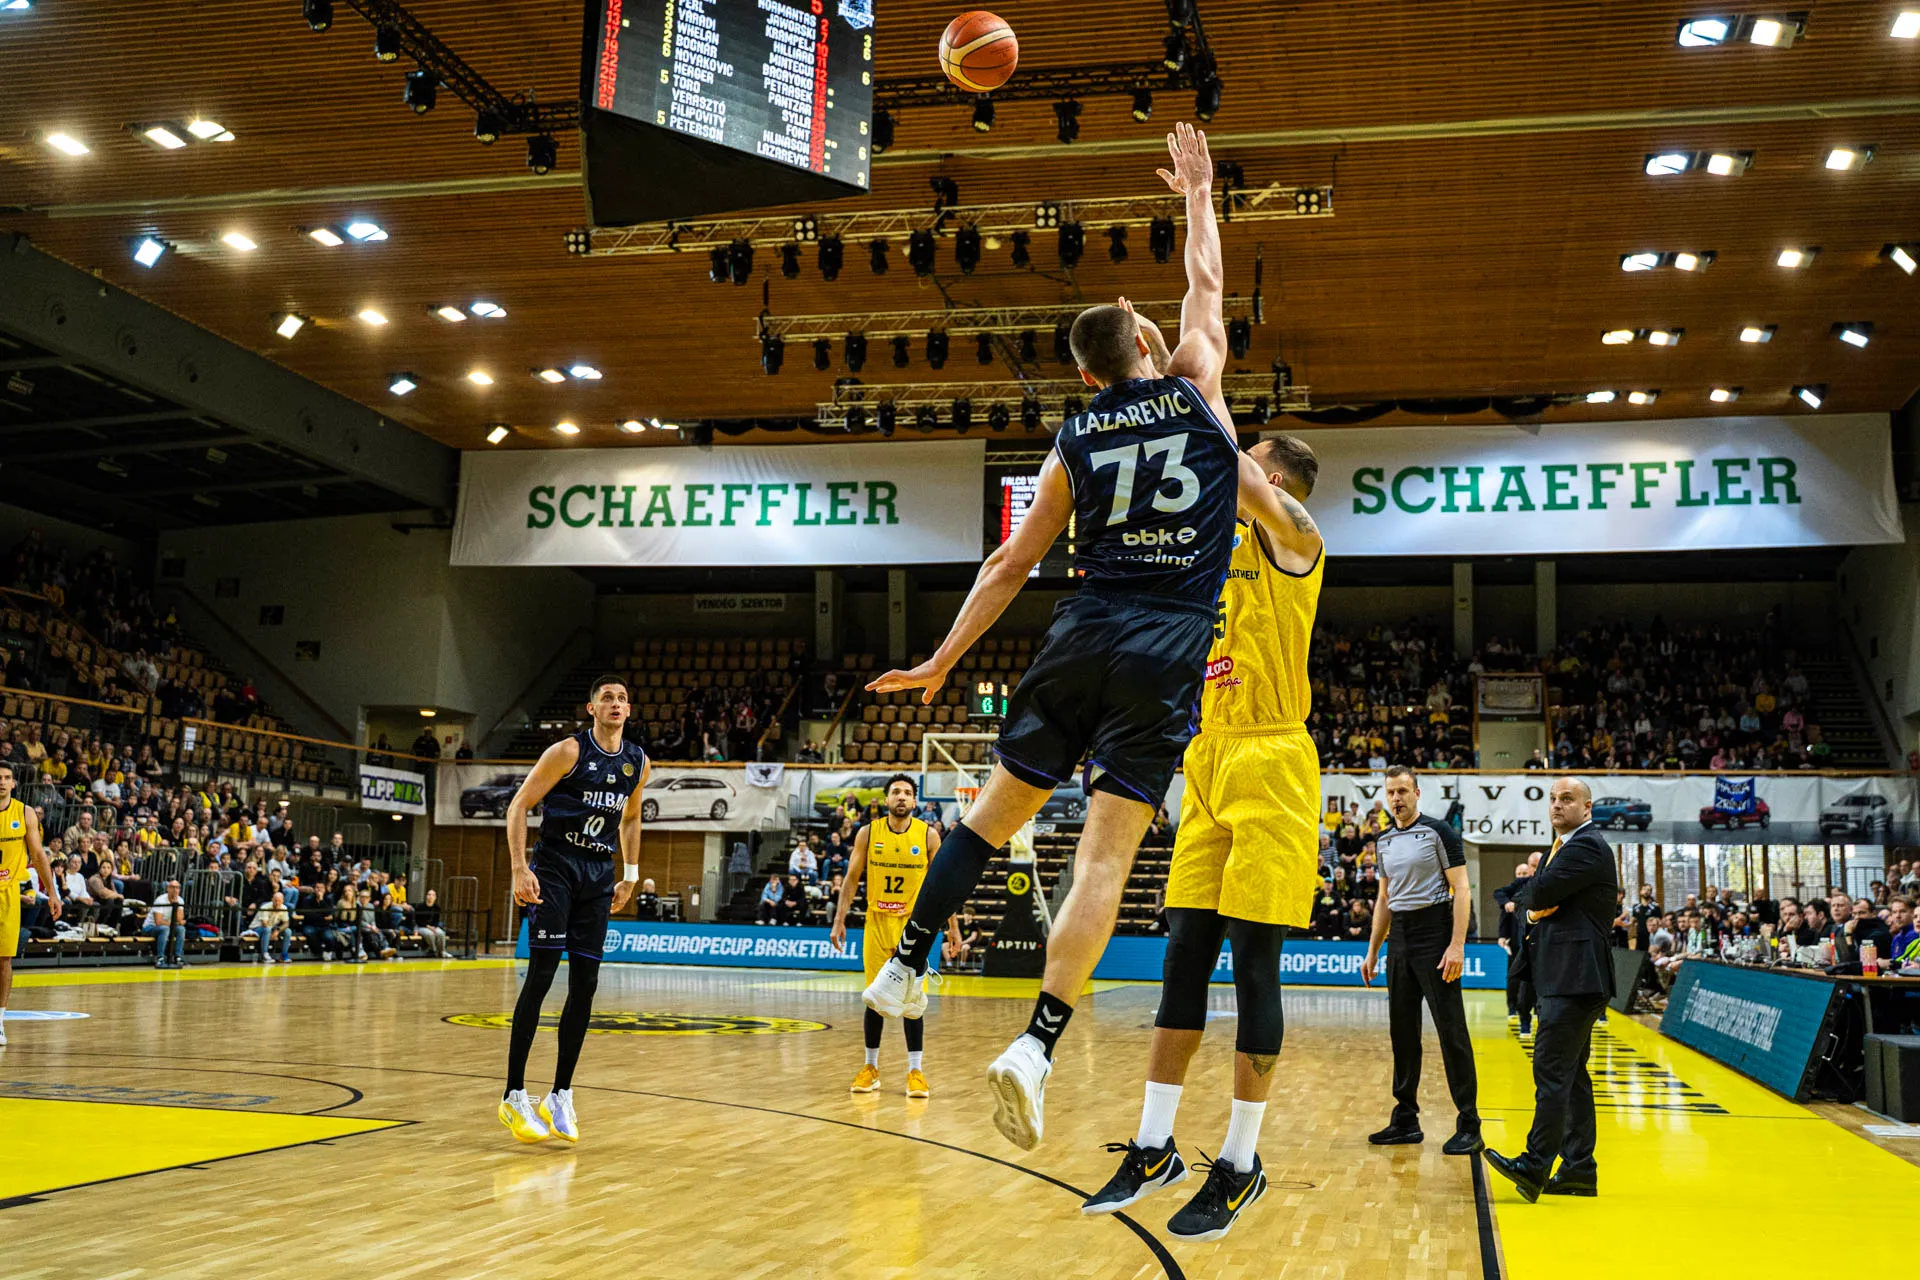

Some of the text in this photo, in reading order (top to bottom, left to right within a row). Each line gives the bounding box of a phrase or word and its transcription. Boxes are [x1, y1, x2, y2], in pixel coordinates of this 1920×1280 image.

[757, 0, 817, 28] NORMANTAS
[663, 29, 673, 43] 2
[677, 20, 719, 45] WHELAN
[766, 13, 816, 40] JAWORSKI
[662, 43, 671, 57] 6
[765, 25, 816, 53] KRAMPELJ
[675, 47, 734, 77] NOVAKOVIC
[773, 40, 815, 65] HILLIARD
[660, 69, 669, 84] 5
[674, 61, 714, 85] HERGER
[762, 63, 813, 90] BAGAYOKO
[769, 52, 815, 78] MINTEGUI
[673, 74, 701, 93] TORO
[763, 76, 813, 103] PETRASEK
[862, 71, 871, 86] 6
[670, 101, 726, 129] FILIPOVITY
[768, 91, 812, 116] PANTZAR
[657, 110, 666, 125] 5
[669, 115, 724, 142] PETERSON
[781, 109, 812, 130] SYLLA
[860, 121, 868, 135] 5
[763, 130, 810, 155] HLINASON
[786, 123, 811, 142] FONT
[757, 141, 809, 168] LAZAREVIC
[858, 146, 867, 160] 6
[1089, 432, 1200, 527] 73
[1352, 457, 1802, 515] SCHAEFFLER
[527, 481, 899, 529] SCHAEFFLER
[1122, 528, 1175, 546] bbk
[1117, 549, 1197, 569] eling
[1356, 785, 1545, 801] VLVO
[582, 815, 605, 837] 10
[1464, 815, 1545, 836] TÓ KFT.
[884, 876, 904, 894] 12
[622, 933, 859, 960] FIBAEUROPECUP.BASKETBALL
[996, 940, 1037, 950] APTIV
